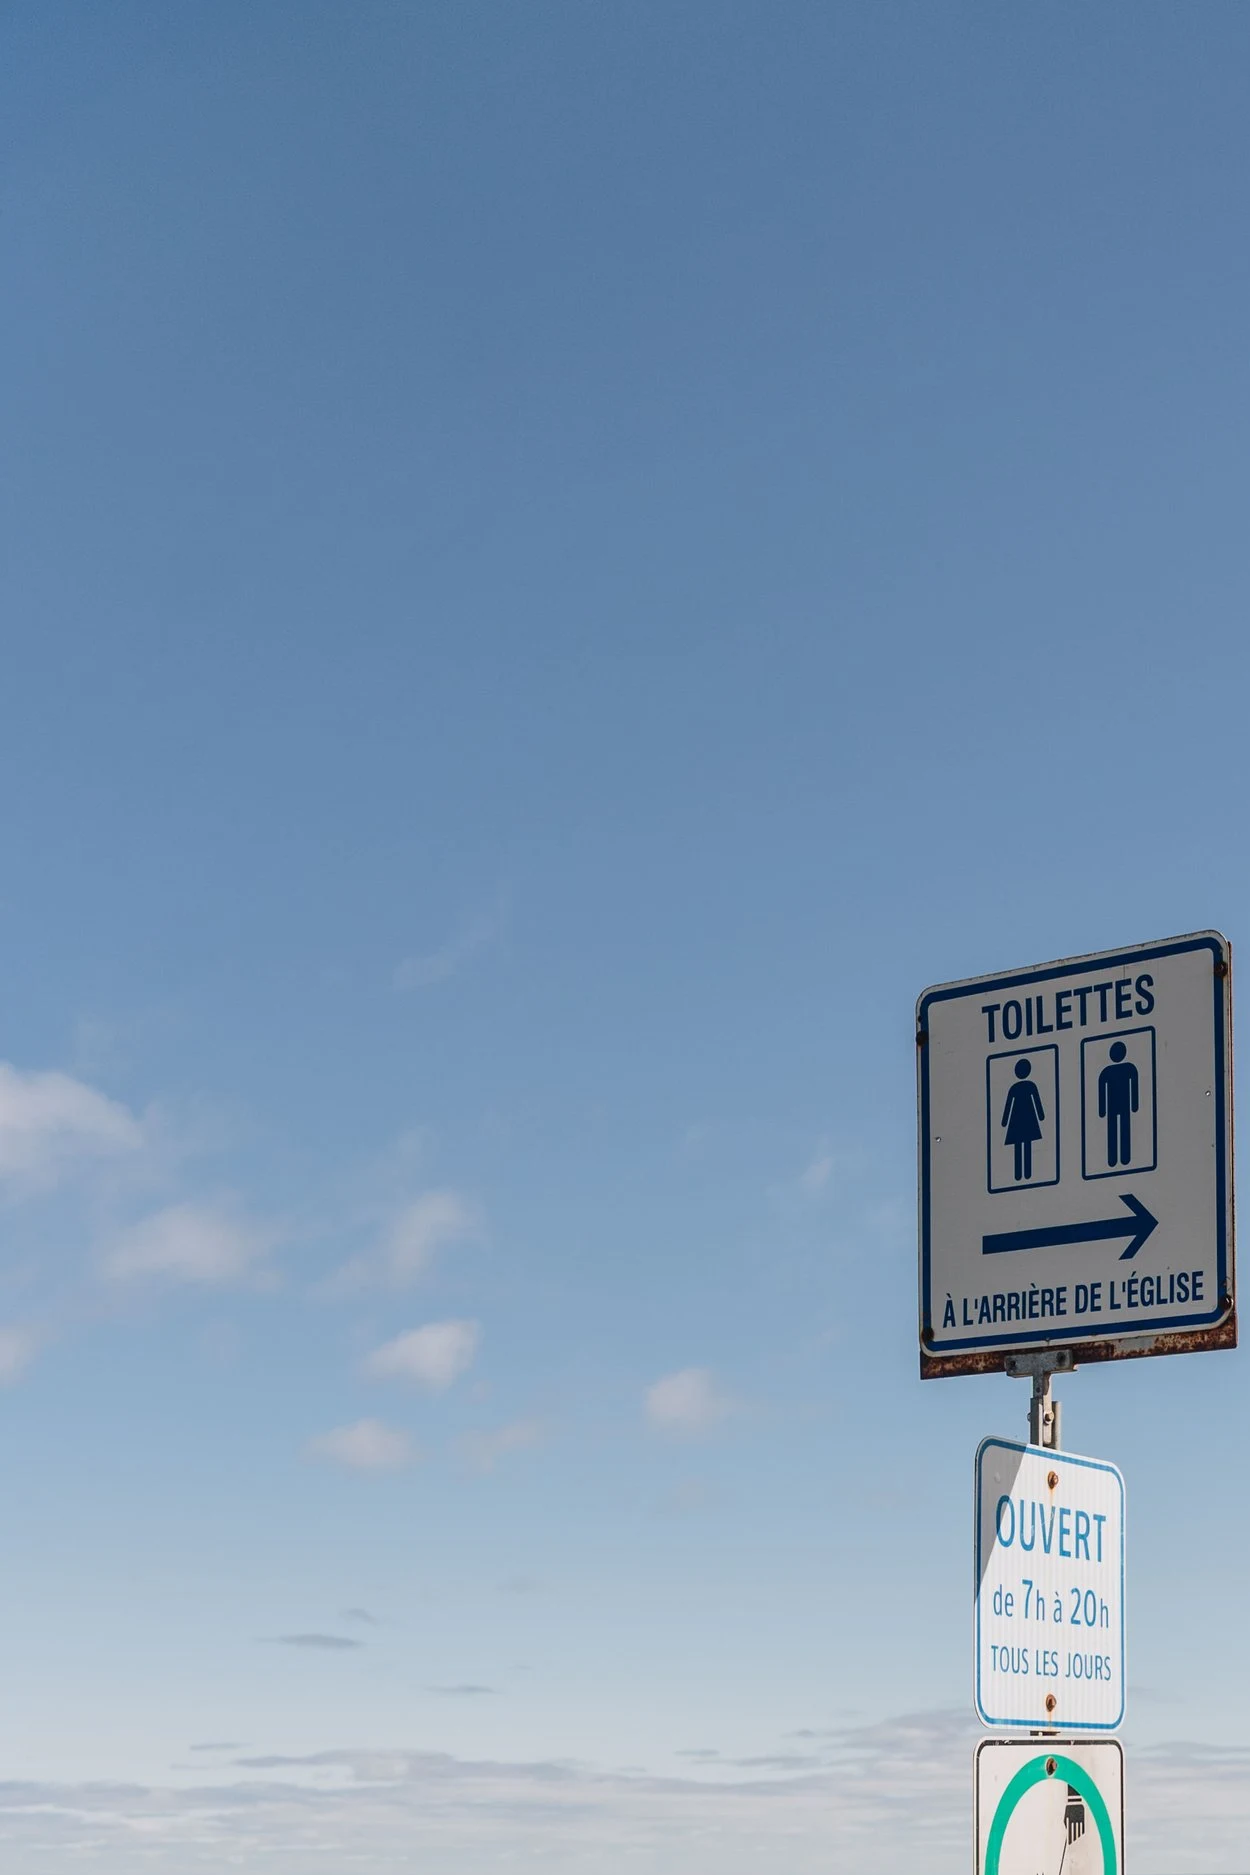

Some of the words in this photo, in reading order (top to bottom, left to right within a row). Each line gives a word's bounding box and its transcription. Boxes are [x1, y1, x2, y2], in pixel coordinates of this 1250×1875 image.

[981, 974, 1155, 1043] TOILETTES
[943, 1293, 956, 1328] À
[963, 1283, 1067, 1326] L'ARRIÈRE
[1075, 1282, 1102, 1314] DE
[1110, 1271, 1204, 1310] L'ÉGLISE
[995, 1494, 1106, 1562] OUVERT
[993, 1584, 1014, 1616] de
[1022, 1579, 1045, 1622] 7h
[1053, 1592, 1062, 1623] à
[1070, 1588, 1109, 1628] 20h
[991, 1645, 1029, 1674] TOUS
[1036, 1650, 1058, 1677] LES
[1065, 1651, 1111, 1681] JOURS
